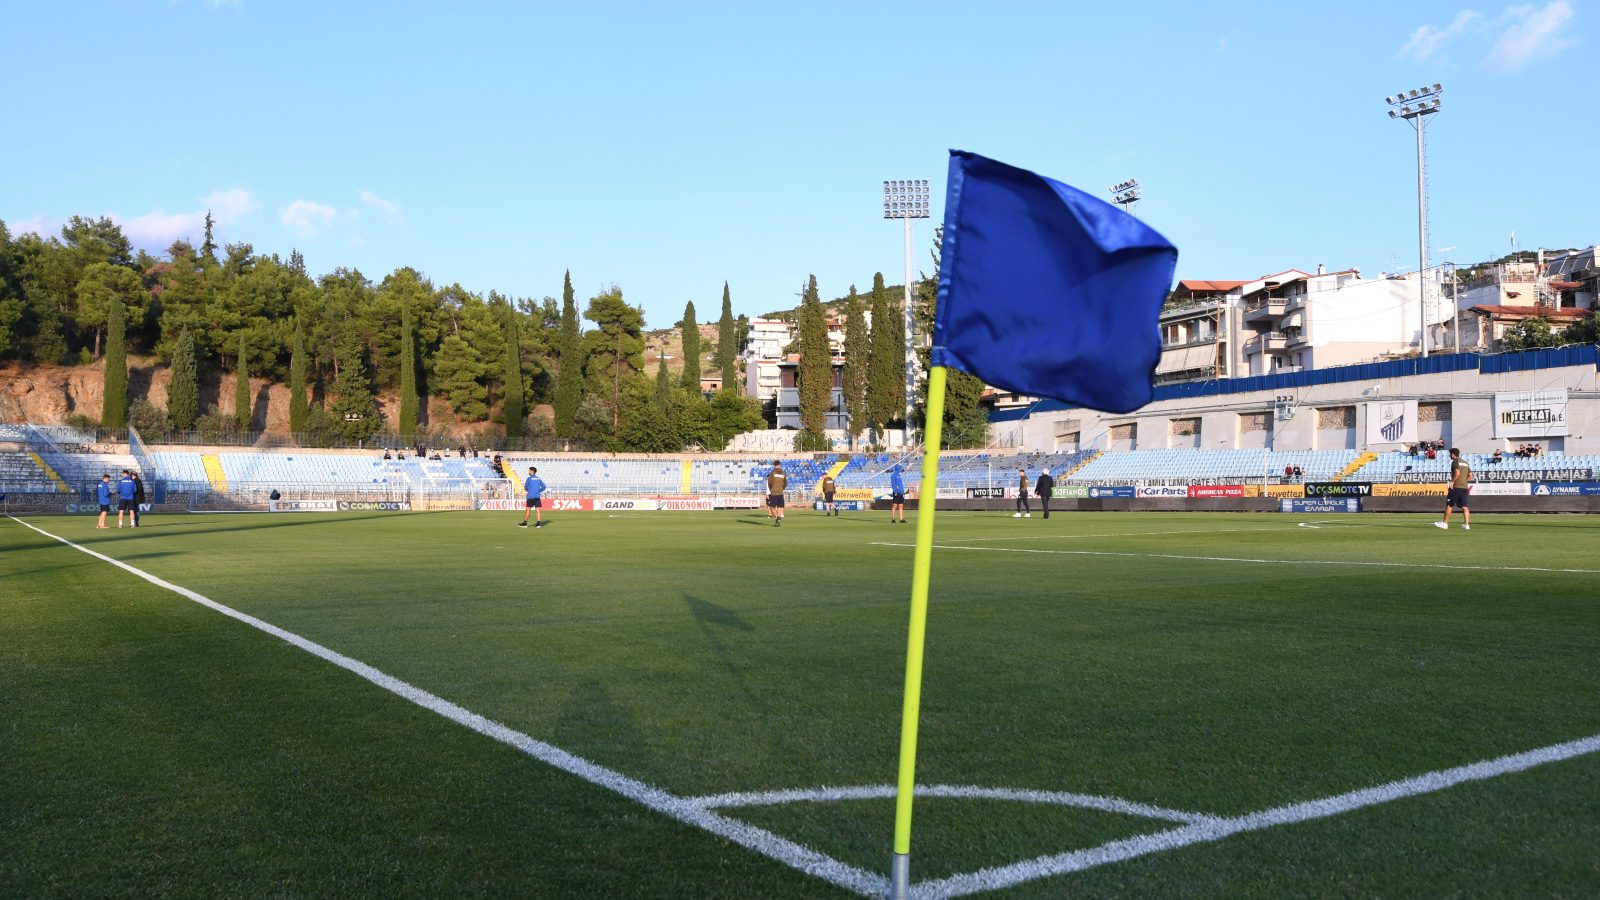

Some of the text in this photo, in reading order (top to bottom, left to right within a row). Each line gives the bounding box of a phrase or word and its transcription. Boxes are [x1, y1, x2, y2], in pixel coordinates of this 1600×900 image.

[1488, 470, 1543, 480] ΦΙΛΑΘΛΩΝ
[1545, 469, 1588, 479] ΛΑΜΙΑΣ
[1054, 488, 1087, 496] SOFIANOS
[1161, 487, 1186, 496] Parts
[1358, 485, 1370, 494] TV
[350, 502, 398, 510] COSMOTE
[552, 499, 583, 511] SYM
